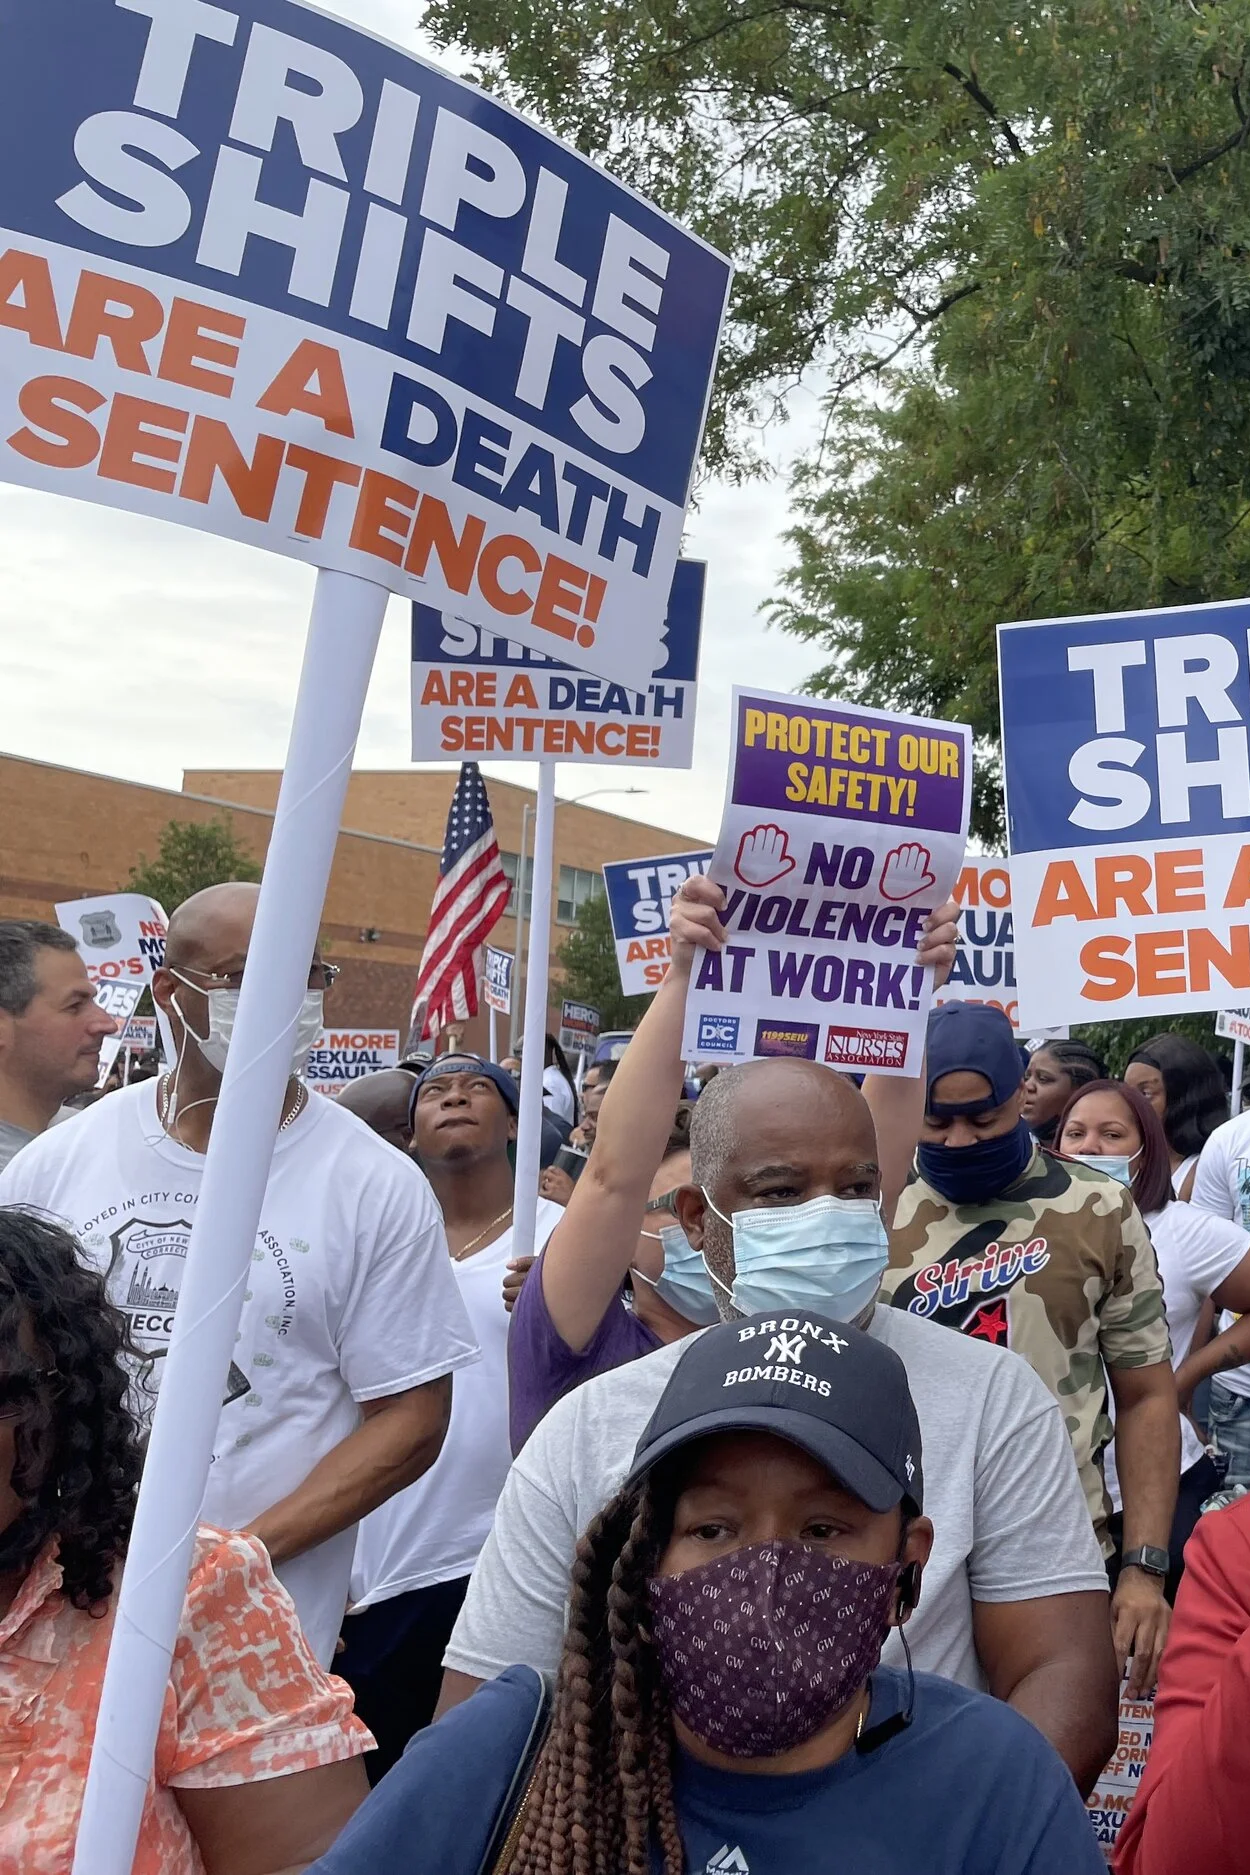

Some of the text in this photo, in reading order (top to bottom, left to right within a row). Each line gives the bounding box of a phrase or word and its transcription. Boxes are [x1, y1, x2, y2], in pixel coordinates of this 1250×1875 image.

[115, 0, 671, 353] TRIPLE
[54, 110, 655, 455] SHIFTS
[0, 248, 661, 579] ARE A DEATH
[6, 375, 608, 649] SENTENCE!
[420, 670, 497, 707] ARE
[503, 674, 539, 709] A
[440, 716, 661, 758] SENTENCE!
[743, 708, 960, 778] PROTECT OUR
[785, 762, 918, 817] SAFETY!
[803, 842, 875, 890] NO
[951, 867, 1031, 908] MO
[1031, 847, 1205, 928] ARE
[715, 884, 934, 949] VIOLENCE
[695, 945, 756, 993] AT
[767, 950, 925, 1011] WORK!
[97, 983, 138, 1018] OES
[329, 1033, 397, 1050] MORE
[762, 1030, 809, 1042] 1199SEIU
[856, 1030, 872, 1039] New
[872, 1032, 888, 1040] York
[701, 1041, 733, 1049] COUNCIL
[827, 1035, 904, 1058] NURSES
[308, 1051, 382, 1064] SEXUAL
[827, 1053, 902, 1066] ASSOCIATION
[76, 1206, 117, 1237] LOYED
[122, 1198, 136, 1211] IN
[140, 1191, 170, 1205] CITY
[135, 1236, 188, 1249] CITY OF NEW
[146, 1247, 187, 1257] CORRECT
[907, 1236, 1051, 1318] Strive
[737, 1316, 850, 1356] BRONX
[763, 1333, 807, 1364] NY
[722, 1364, 833, 1397] BOMBERS
[730, 1567, 749, 1582] GW
[784, 1570, 805, 1588] GW
[856, 1568, 873, 1585] GW
[702, 1584, 722, 1599] GW
[812, 1587, 832, 1604] GW
[678, 1602, 694, 1616] GW
[741, 1601, 755, 1616] GW
[837, 1603, 856, 1620] GW
[663, 1615, 676, 1631] GW
[713, 1619, 731, 1635] GW
[793, 1620, 811, 1638] GW
[858, 1616, 873, 1633] GW
[692, 1636, 707, 1651] GW
[751, 1637, 770, 1650] GW
[817, 1636, 836, 1653] GW
[675, 1650, 688, 1665] GW
[726, 1655, 744, 1669] GW
[841, 1651, 857, 1668] GW
[707, 1671, 723, 1686] GW
[809, 1671, 823, 1688] GW
[690, 1684, 706, 1699] GW
[725, 1705, 744, 1718] GW
